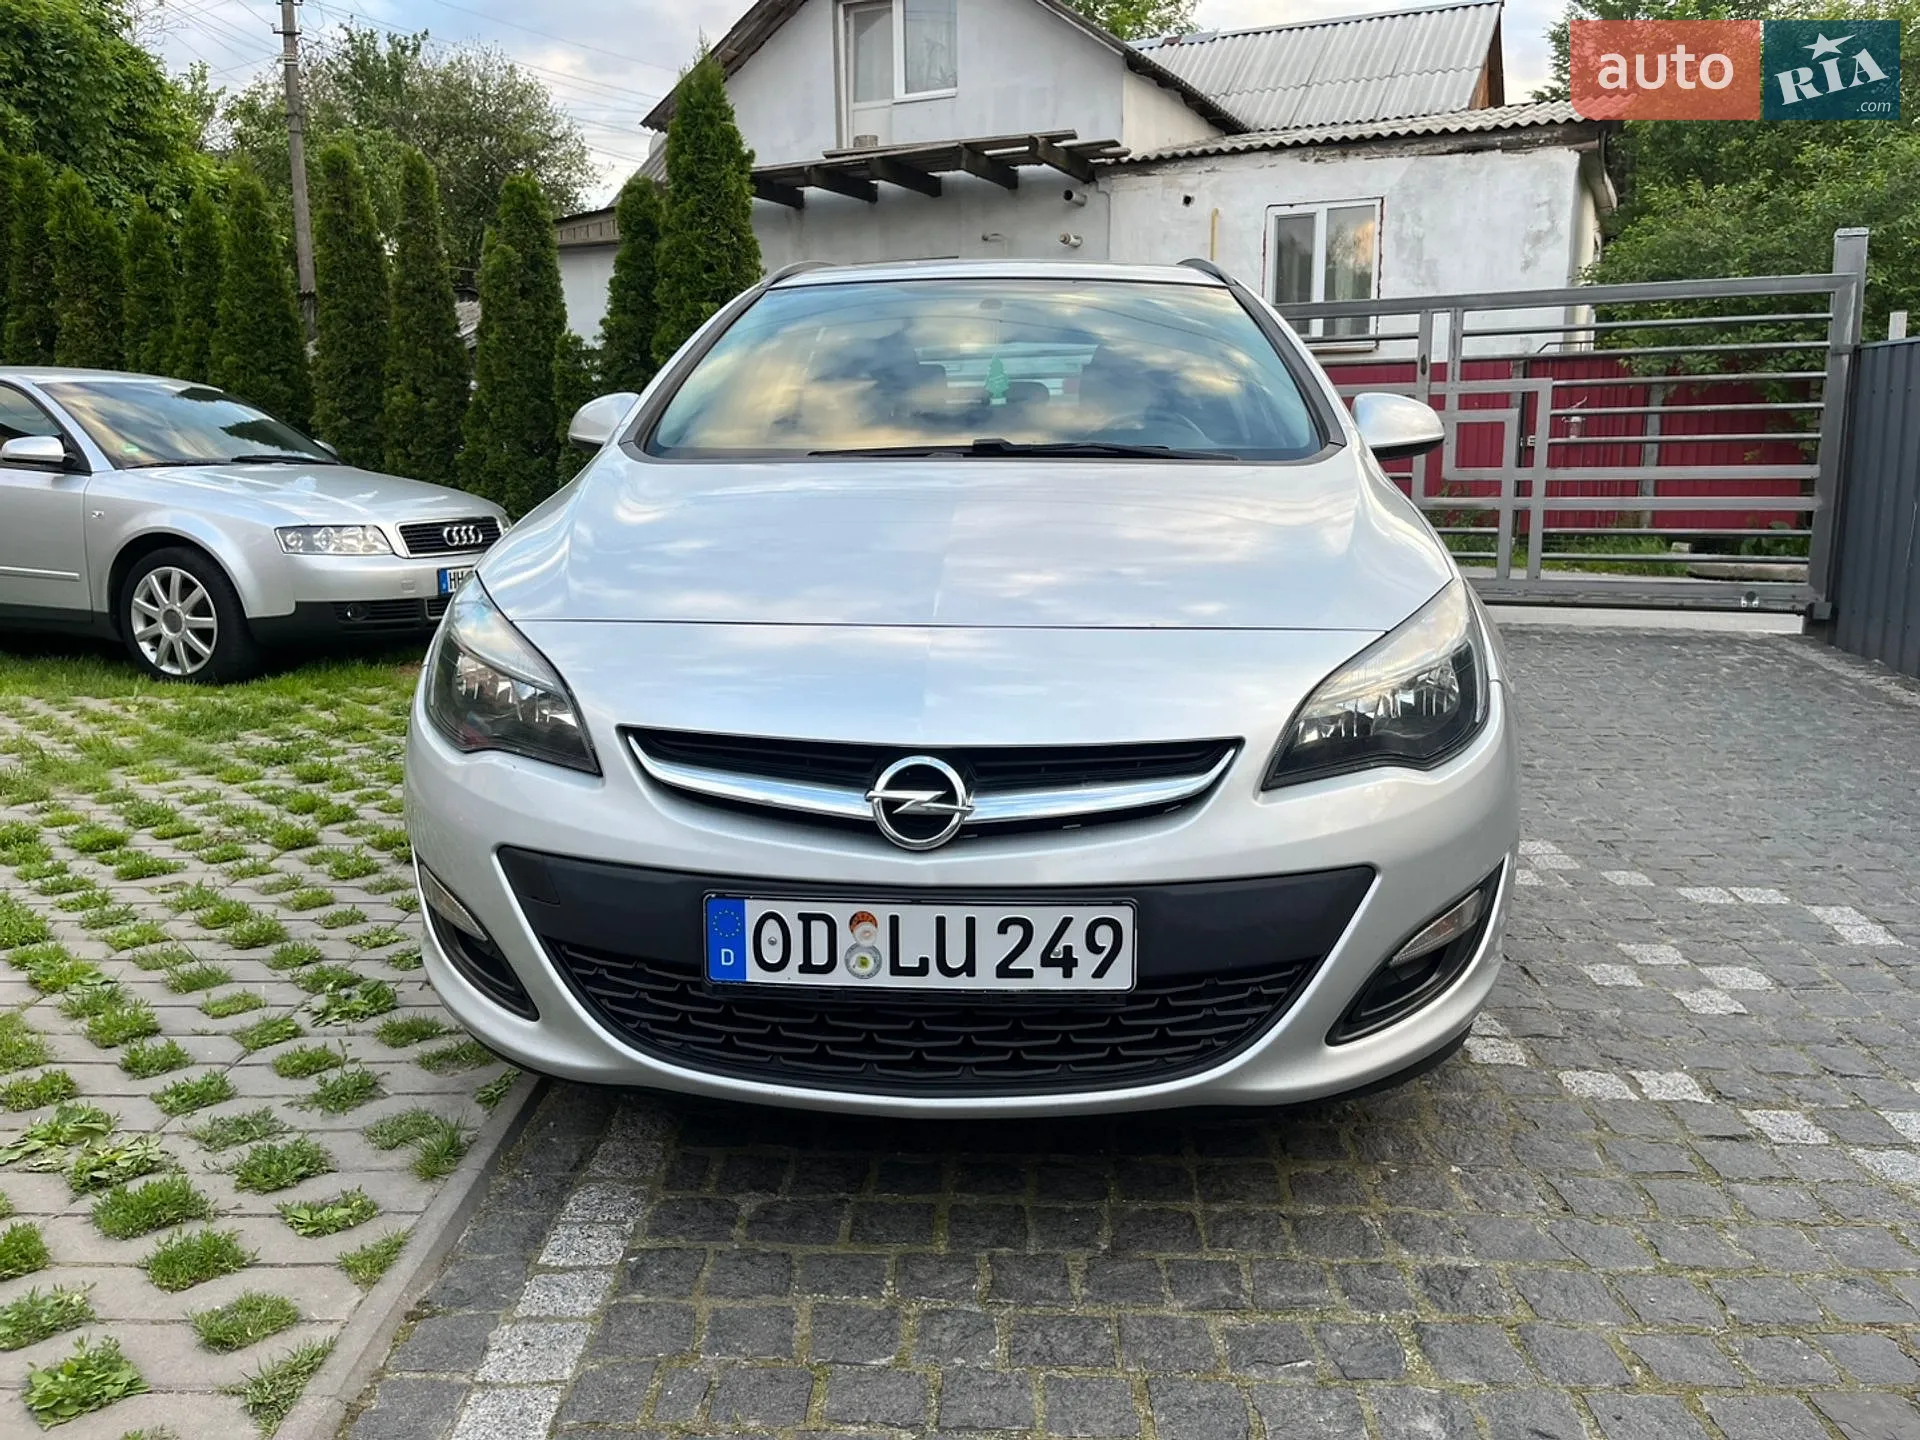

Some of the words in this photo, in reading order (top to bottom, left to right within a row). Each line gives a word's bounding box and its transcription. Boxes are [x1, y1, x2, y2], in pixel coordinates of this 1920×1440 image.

[720, 948, 735, 966] D
[752, 910, 839, 976] OD
[889, 914, 977, 978] LU
[995, 915, 1124, 979] 249
